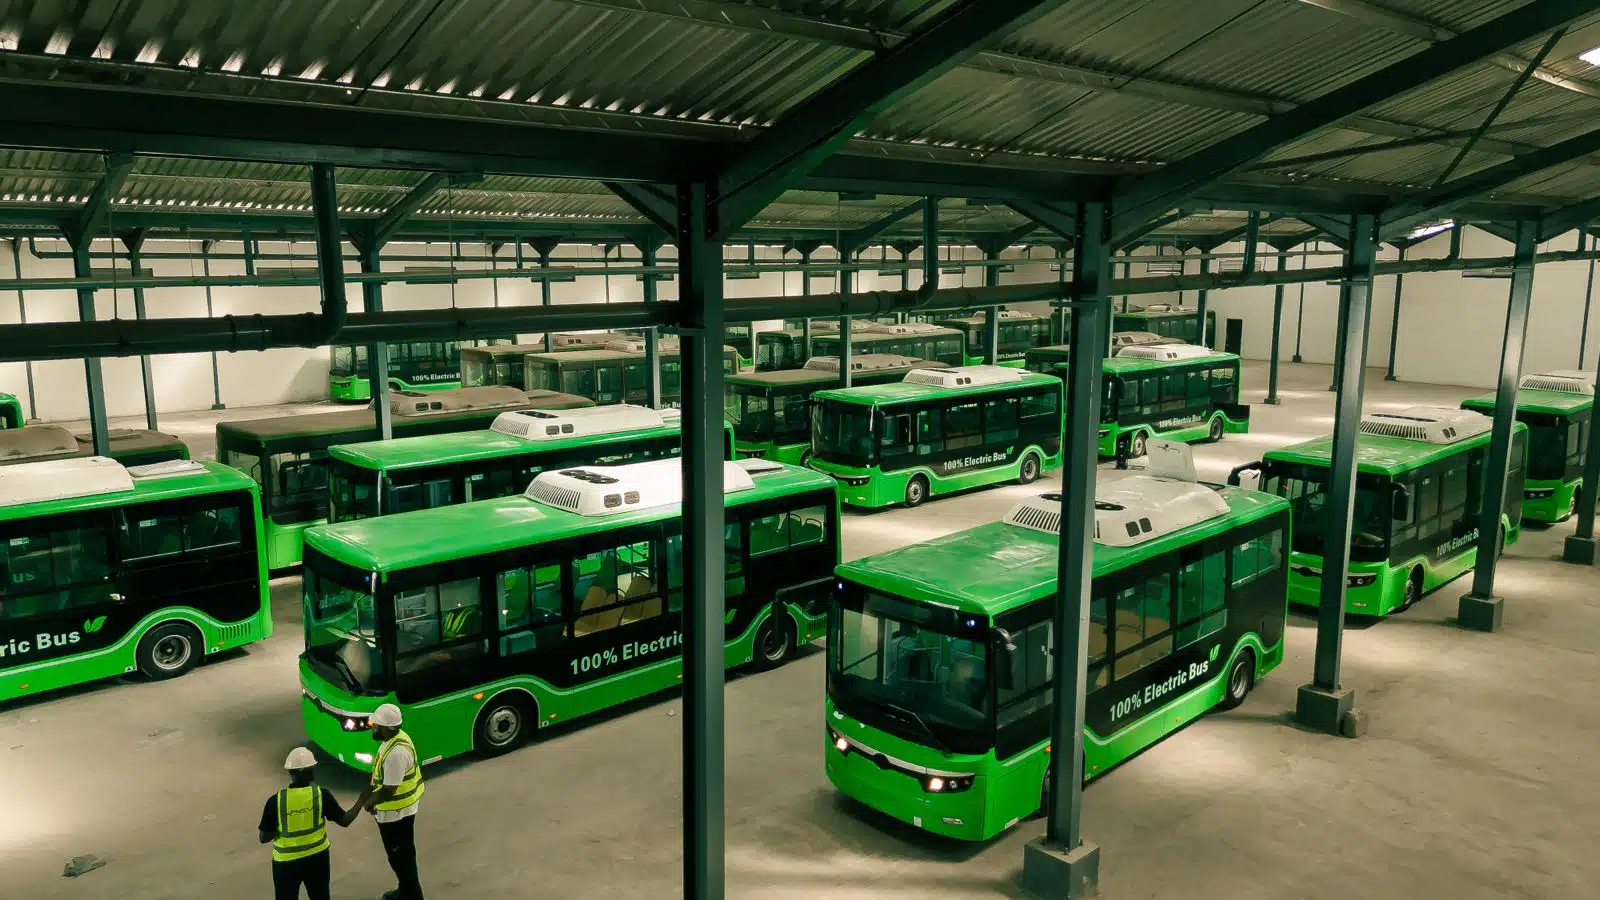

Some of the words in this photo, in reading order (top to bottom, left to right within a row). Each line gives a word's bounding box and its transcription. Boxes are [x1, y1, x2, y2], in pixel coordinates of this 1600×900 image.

[430, 372, 455, 380] Electric
[943, 458, 964, 471] 100%
[964, 454, 993, 467] Electric
[992, 452, 1007, 462] Bus
[36, 631, 81, 650] Bus
[570, 646, 618, 675] 100%
[1110, 690, 1142, 722] 100%
[1144, 670, 1188, 704] Electric
[1188, 660, 1209, 681] Bus
